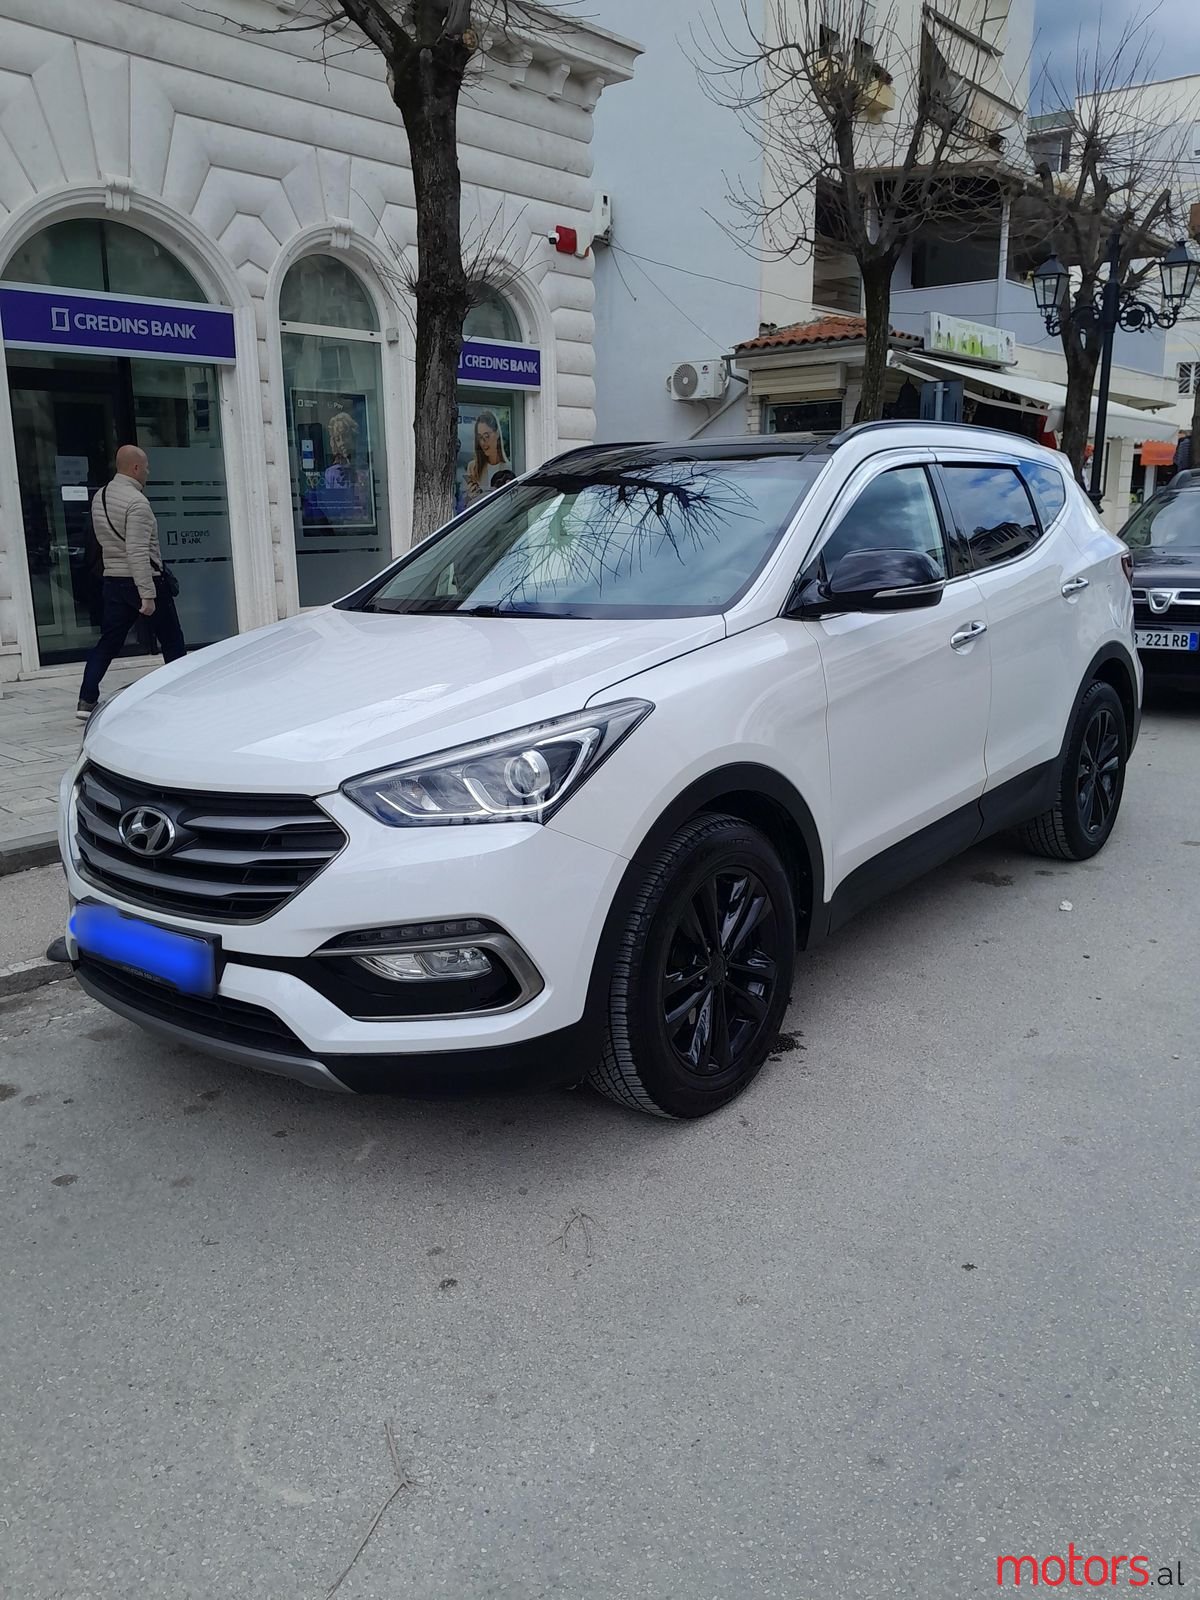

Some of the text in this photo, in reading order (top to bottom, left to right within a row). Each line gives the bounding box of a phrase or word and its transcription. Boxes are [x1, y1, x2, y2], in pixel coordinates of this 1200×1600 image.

[74, 313, 197, 340] CREDINS BANK
[465, 354, 538, 374] CREDINS BANK
